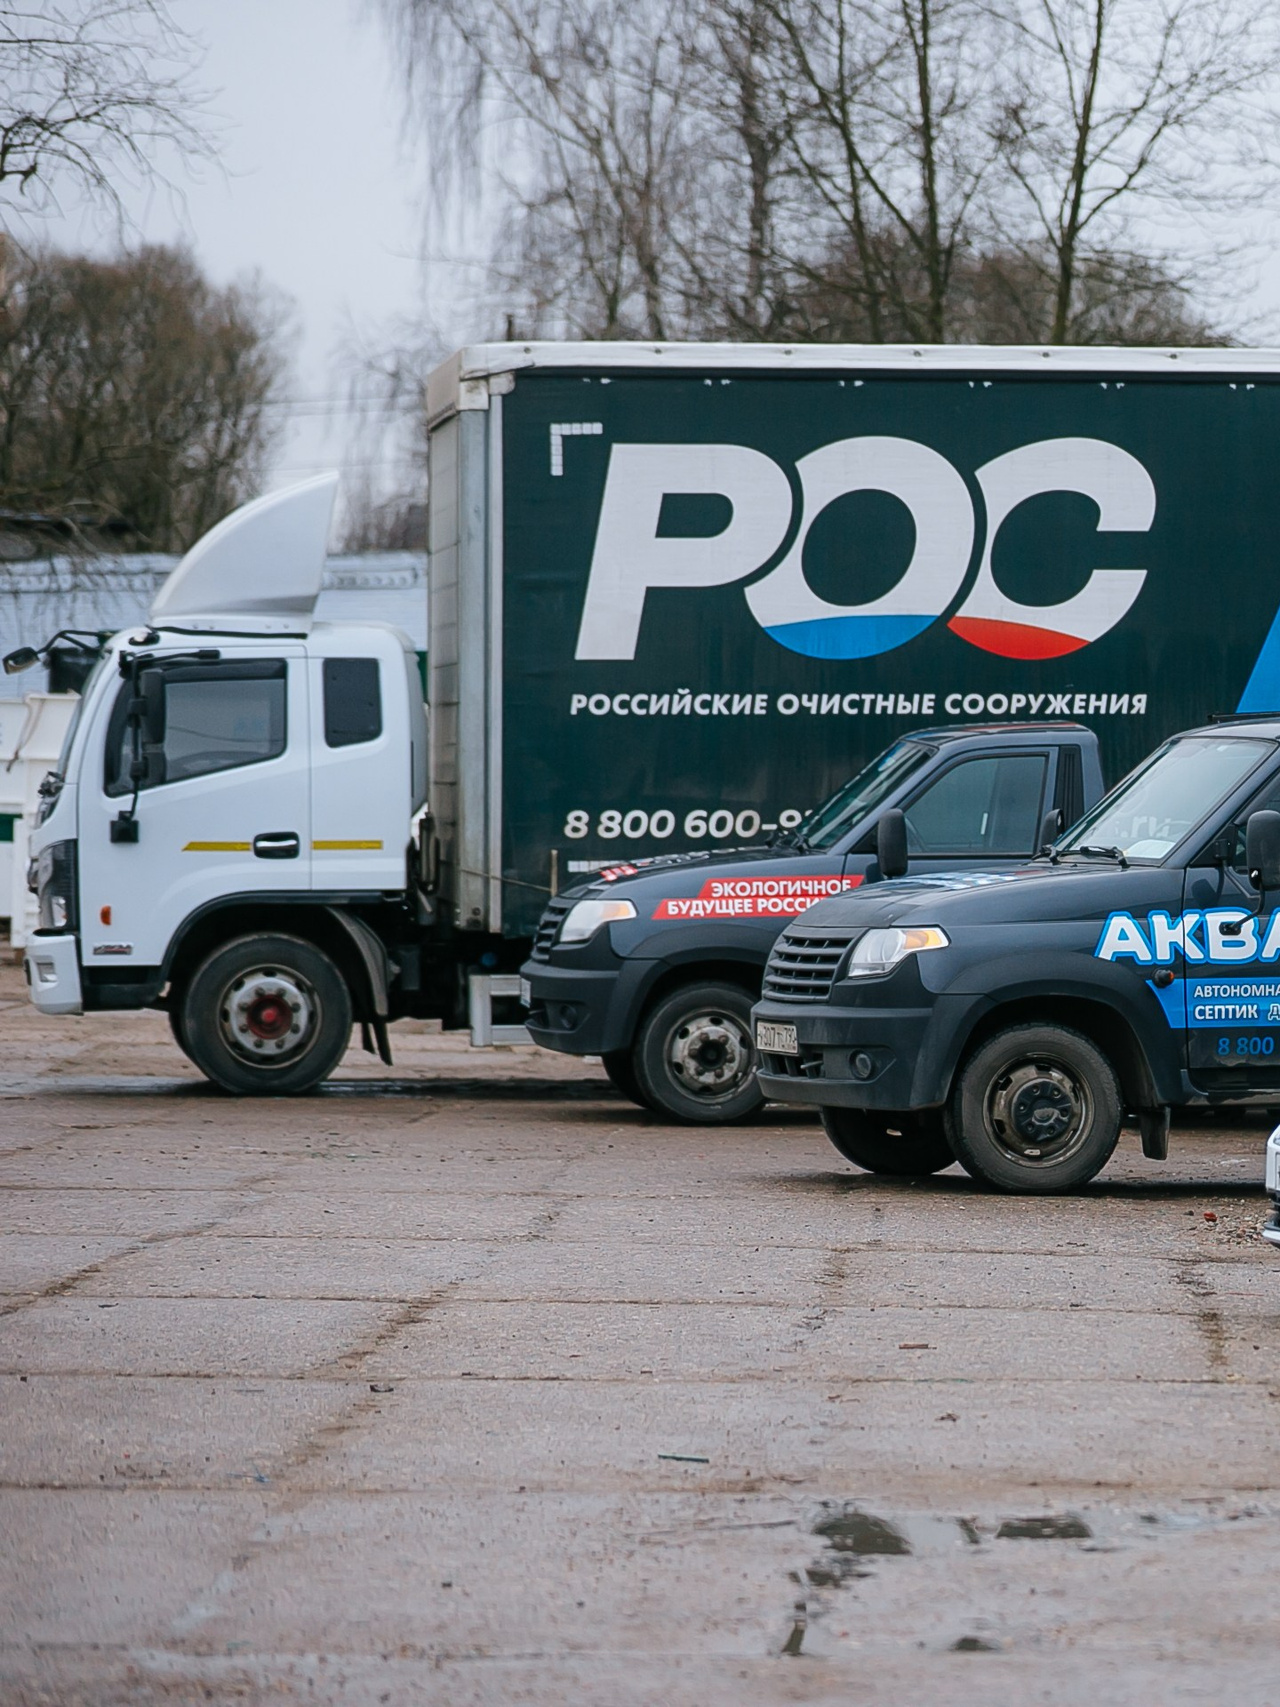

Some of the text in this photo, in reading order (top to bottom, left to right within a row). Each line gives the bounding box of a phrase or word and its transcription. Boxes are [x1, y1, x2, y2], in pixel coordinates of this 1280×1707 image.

[575, 436, 1156, 660] РОС
[570, 688, 1148, 716] РОССИЙСКИЕ ОЧИСТНЫЕ СООРУЖЕНИЯ
[564, 809, 813, 838] 8 800 600-9
[668, 896, 827, 917] БУДУЩЕЕ РОССИ
[1194, 1004, 1259, 1020] СЕПТИК
[1218, 1037, 1230, 1056] 8
[1236, 1036, 1275, 1055] 800
